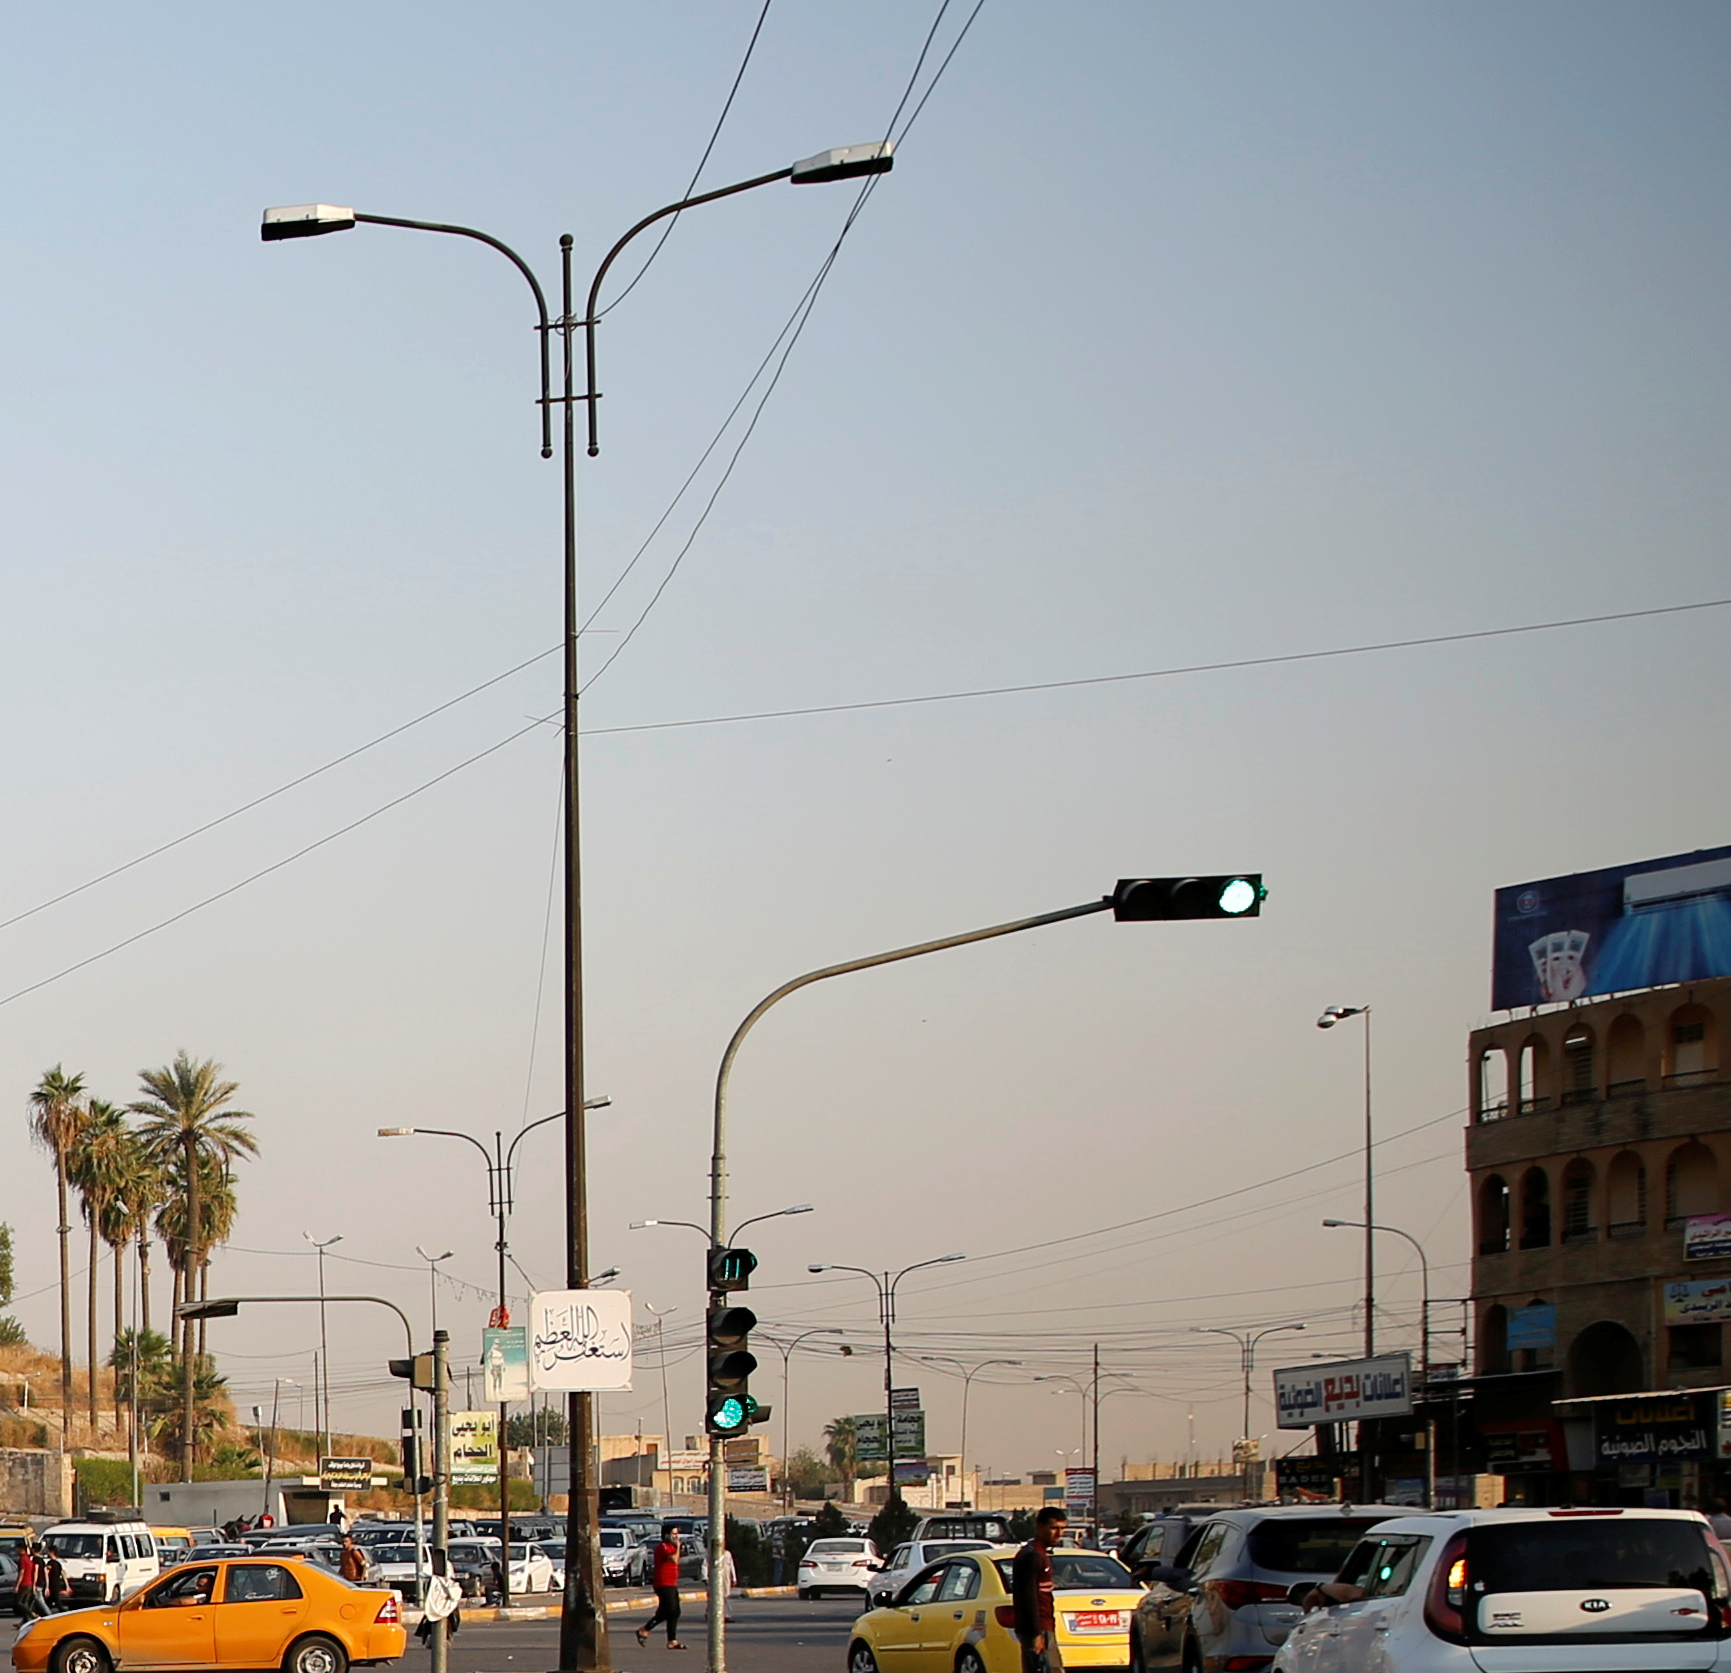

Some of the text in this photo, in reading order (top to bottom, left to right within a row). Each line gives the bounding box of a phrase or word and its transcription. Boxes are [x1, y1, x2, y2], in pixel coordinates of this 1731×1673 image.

[534, 1305, 578, 1370] العظيم
[543, 1322, 630, 1371] استغفر
[1279, 1380, 1322, 1418] الضوئية
[1323, 1374, 1360, 1413] بديع
[454, 1444, 492, 1464] الحجام
[1657, 1429, 1707, 1456] النجوم
[1584, 1601, 1606, 1609] KIA
